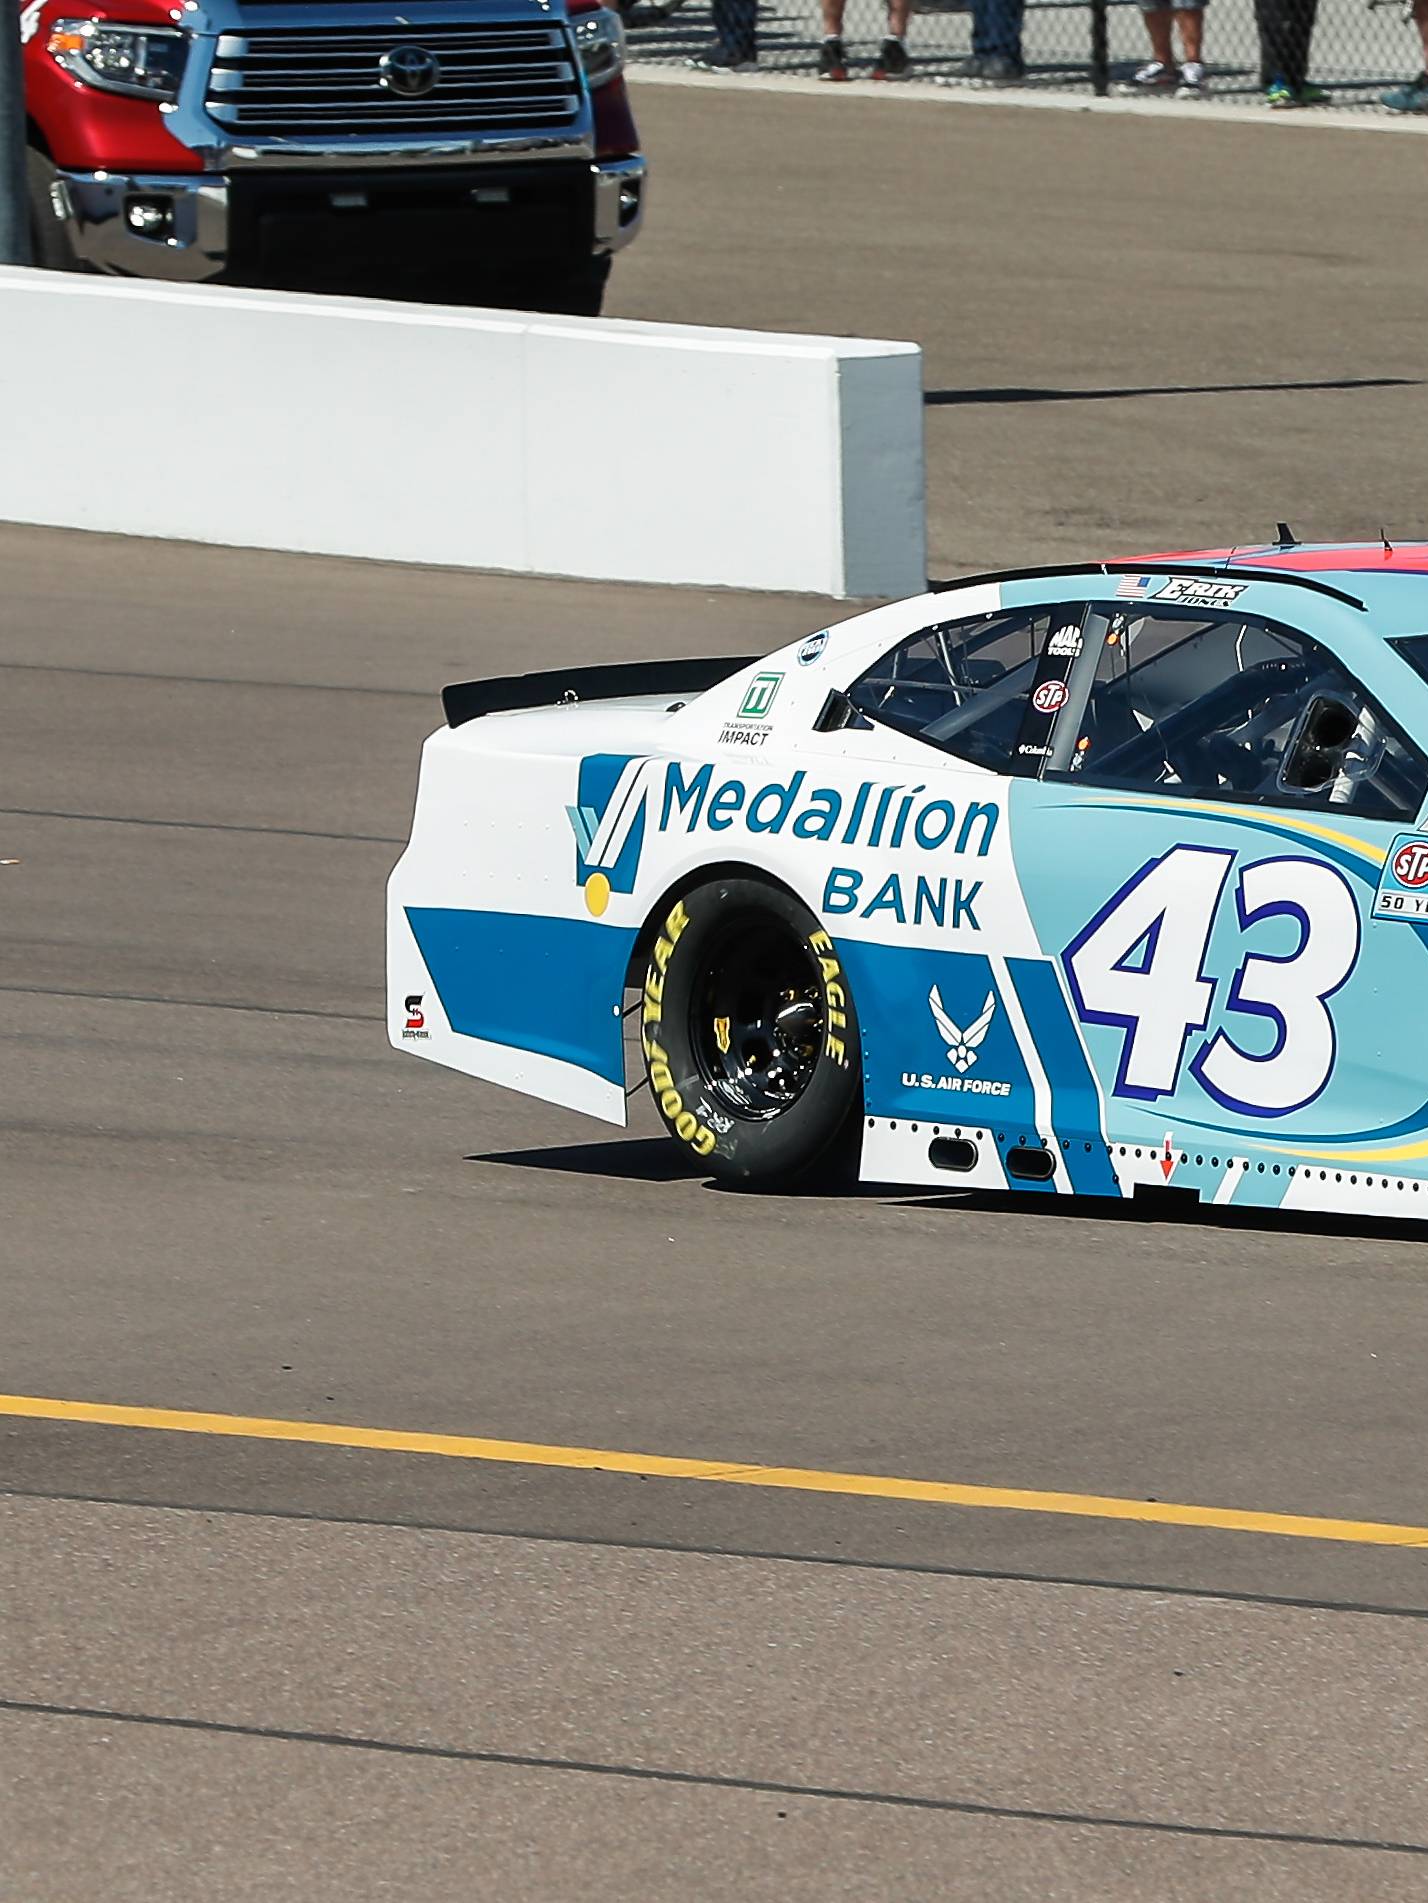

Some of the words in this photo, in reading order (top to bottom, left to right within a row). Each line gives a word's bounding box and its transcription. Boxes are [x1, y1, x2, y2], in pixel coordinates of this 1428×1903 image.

[1155, 578, 1244, 600] ERIK
[1036, 684, 1063, 707] STP
[718, 730, 768, 745] IMPACT
[658, 761, 1000, 857] Medallion
[822, 867, 984, 931] BANK
[1380, 895, 1404, 910] 50
[808, 929, 847, 1066] EAGLE
[1061, 843, 1361, 1118] 43
[642, 900, 717, 1156] GOODYEAR
[902, 1072, 936, 1089] U.S.
[936, 1076, 962, 1092] AIR
[962, 1079, 1011, 1096] FORCE
